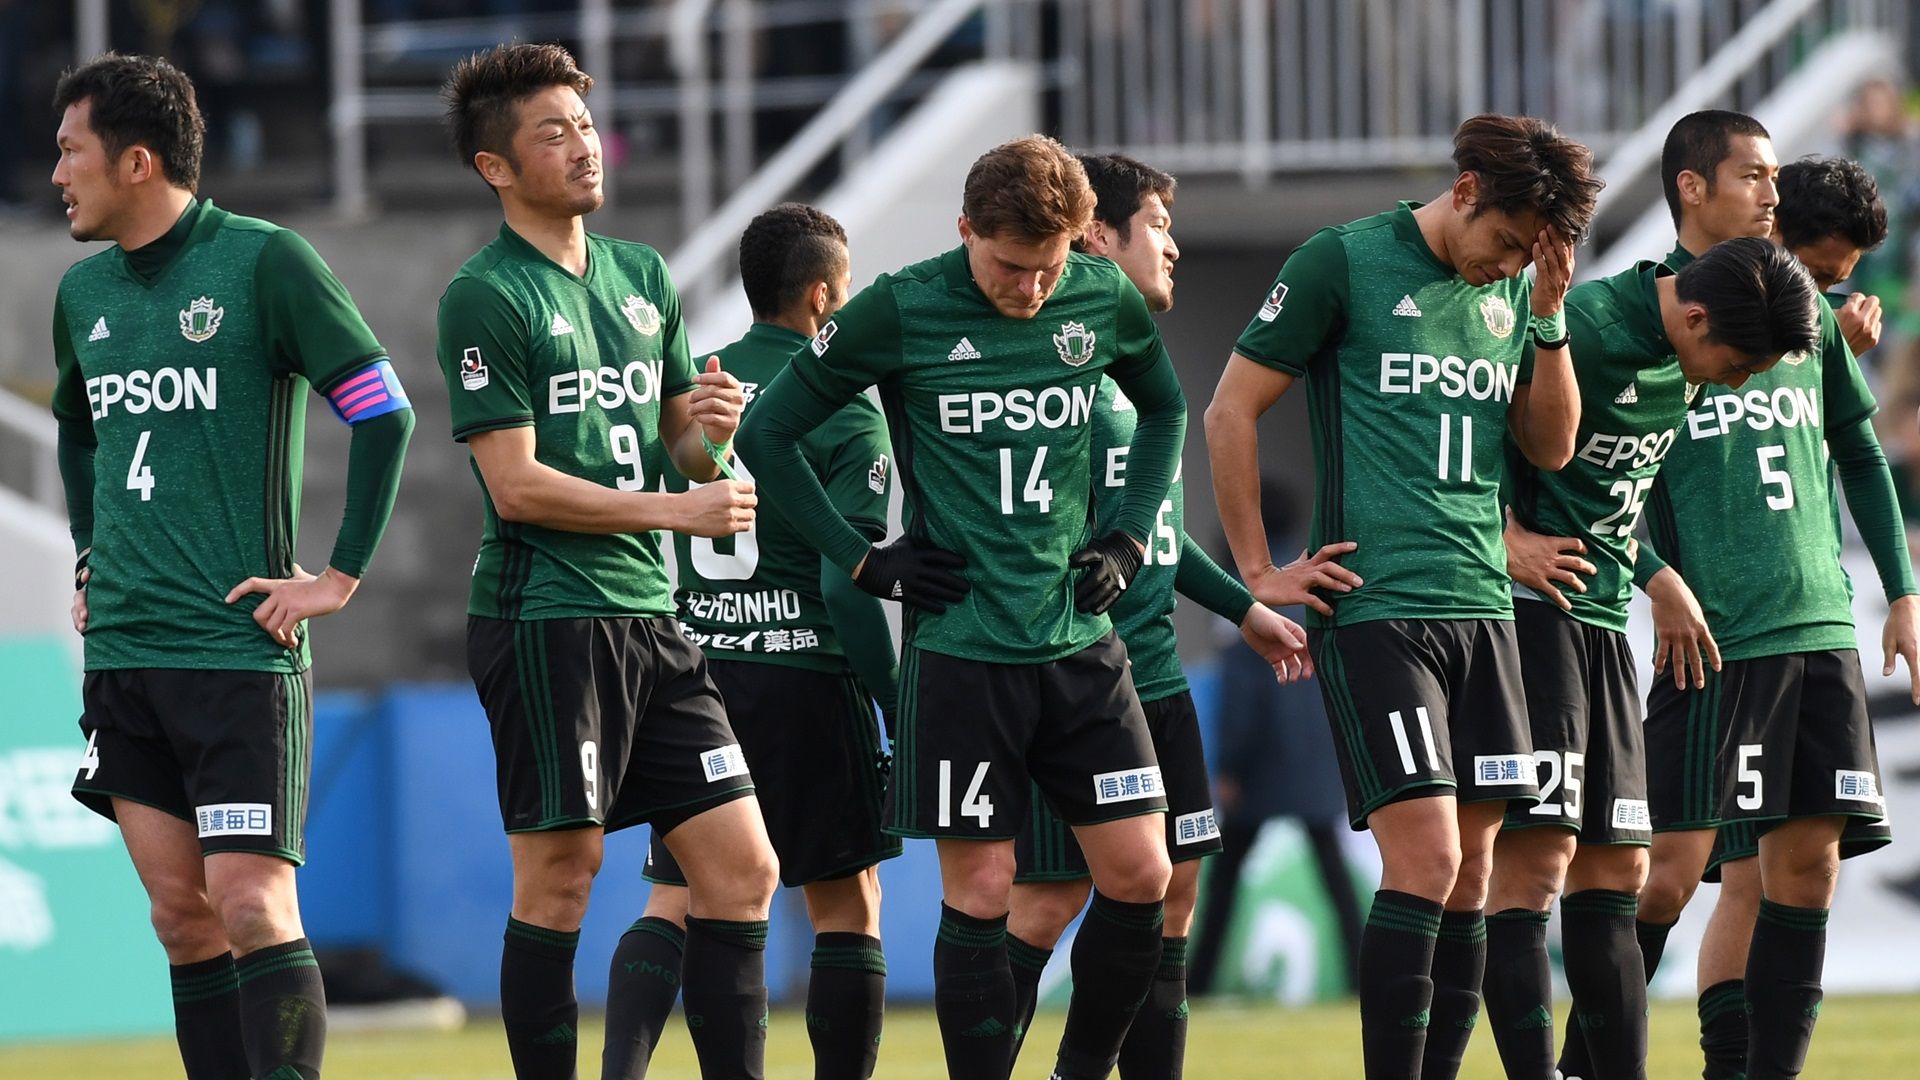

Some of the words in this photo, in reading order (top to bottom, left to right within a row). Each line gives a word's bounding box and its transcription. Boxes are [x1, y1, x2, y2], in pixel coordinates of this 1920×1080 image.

[1392, 308, 1421, 317] adidas
[948, 351, 981, 361] adidas
[1380, 353, 1518, 404] EPSON
[86, 367, 217, 421] EPSON
[939, 384, 1096, 433] EPSON
[1688, 386, 1820, 440] EPSON
[126, 431, 155, 501] 4
[609, 424, 645, 491] 9
[999, 446, 1053, 515] 14
[1438, 413, 1472, 482] 11
[1756, 445, 1795, 511] 5
[1591, 477, 1654, 537] 25
[80, 728, 100, 780] 4
[1388, 706, 1440, 775] 11
[580, 741, 598, 809] 9
[938, 759, 994, 828] 14
[1529, 750, 1584, 819] 25
[1736, 744, 1763, 811] 5
